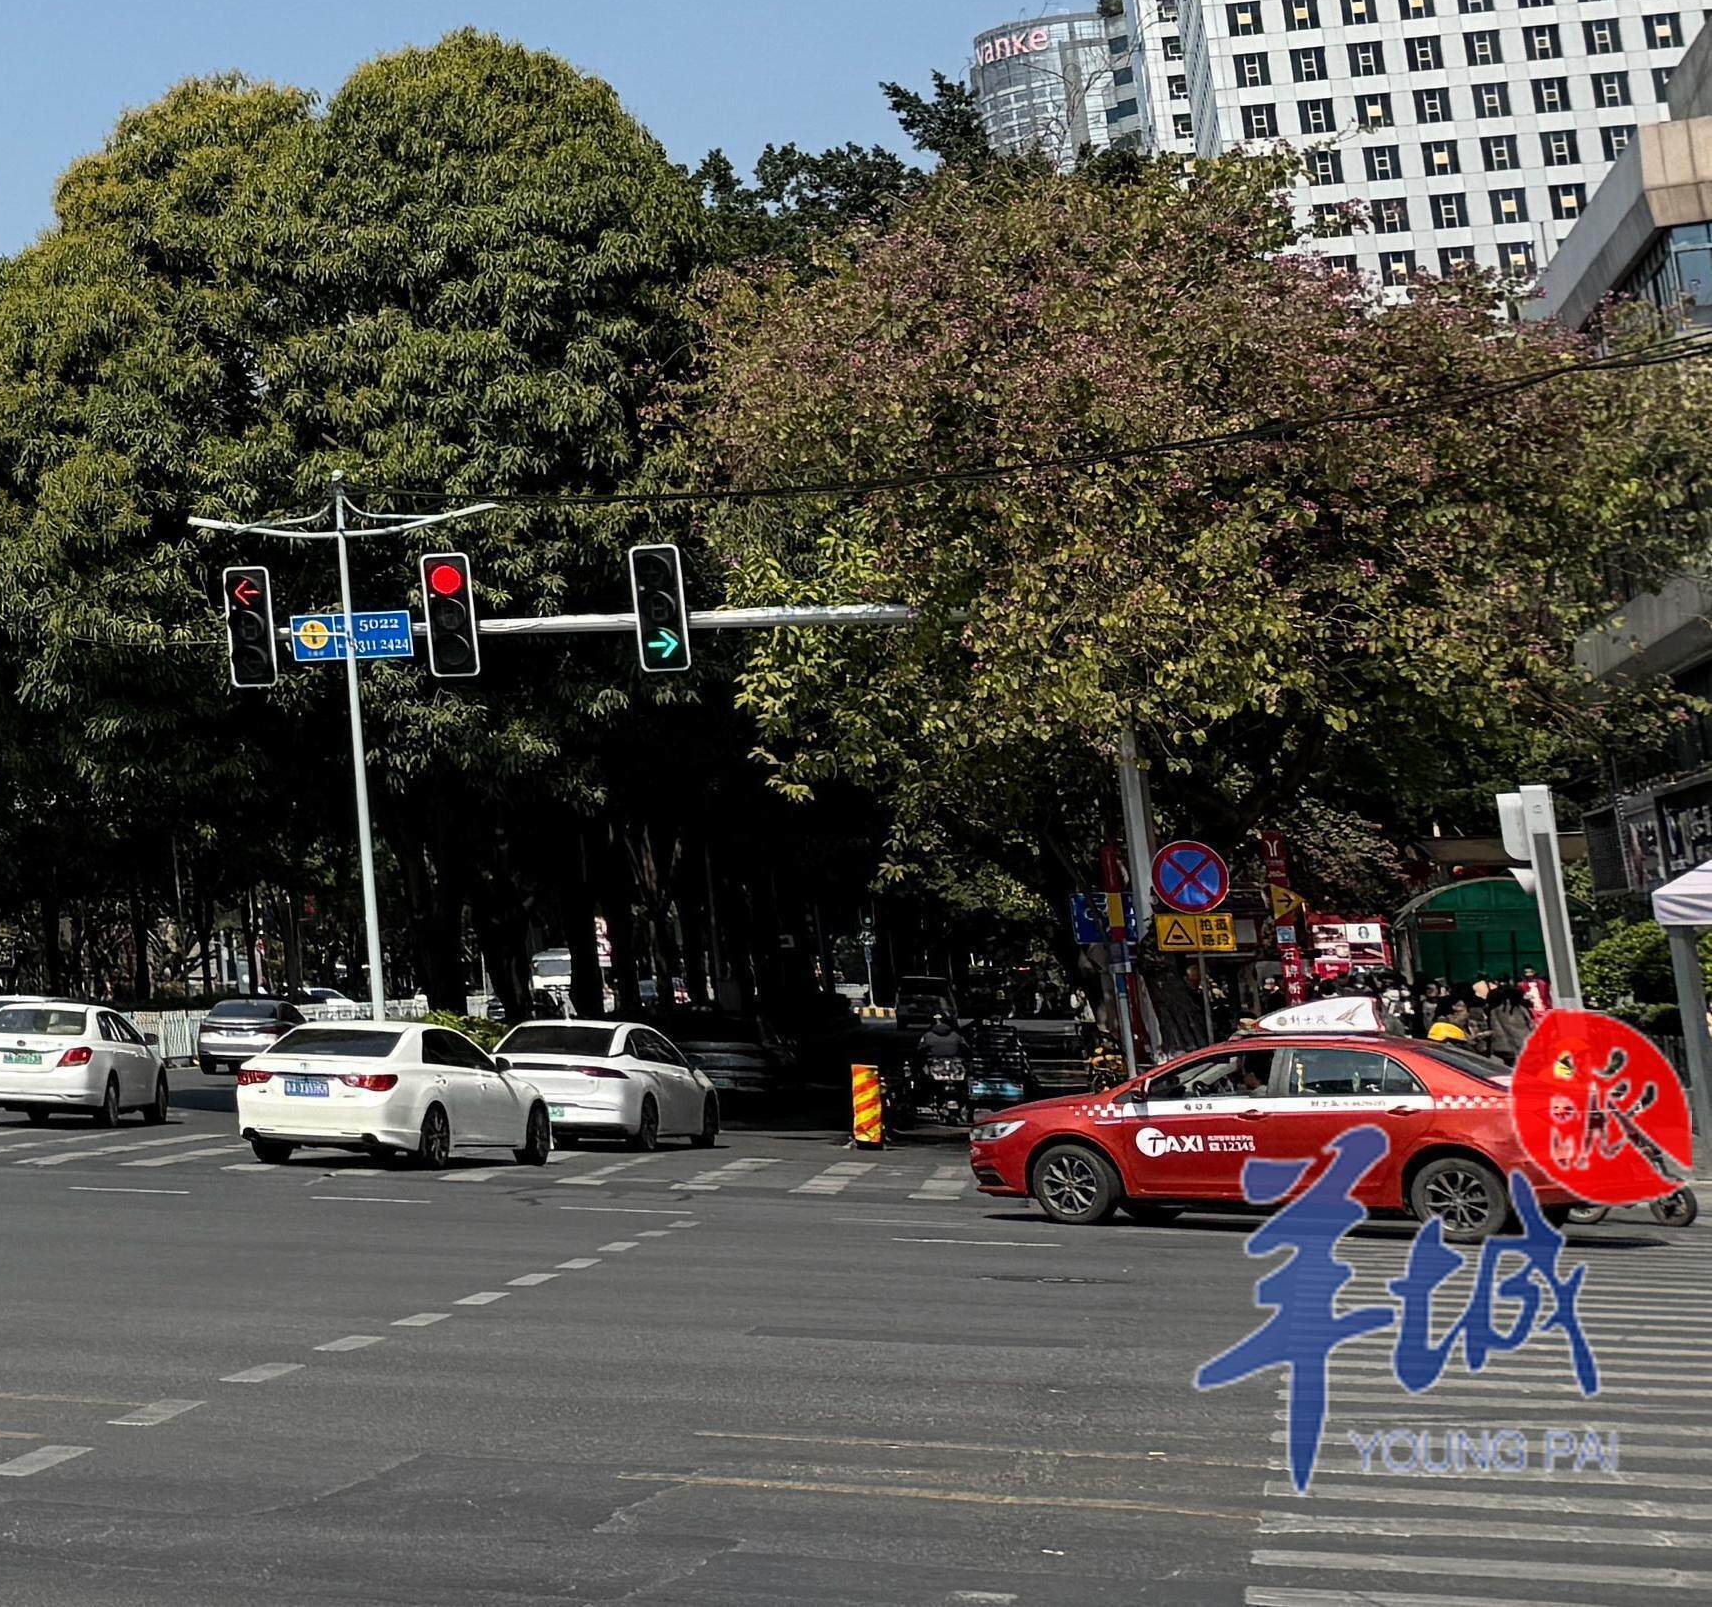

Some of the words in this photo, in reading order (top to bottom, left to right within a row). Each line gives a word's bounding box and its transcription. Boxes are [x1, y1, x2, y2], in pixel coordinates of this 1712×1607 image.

[976, 30, 1048, 67] vanke
[359, 618, 400, 633] 5022
[380, 638, 409, 651] 2424
[1137, 1127, 1203, 1157] TAXI
[1223, 1141, 1256, 1152] 12345
